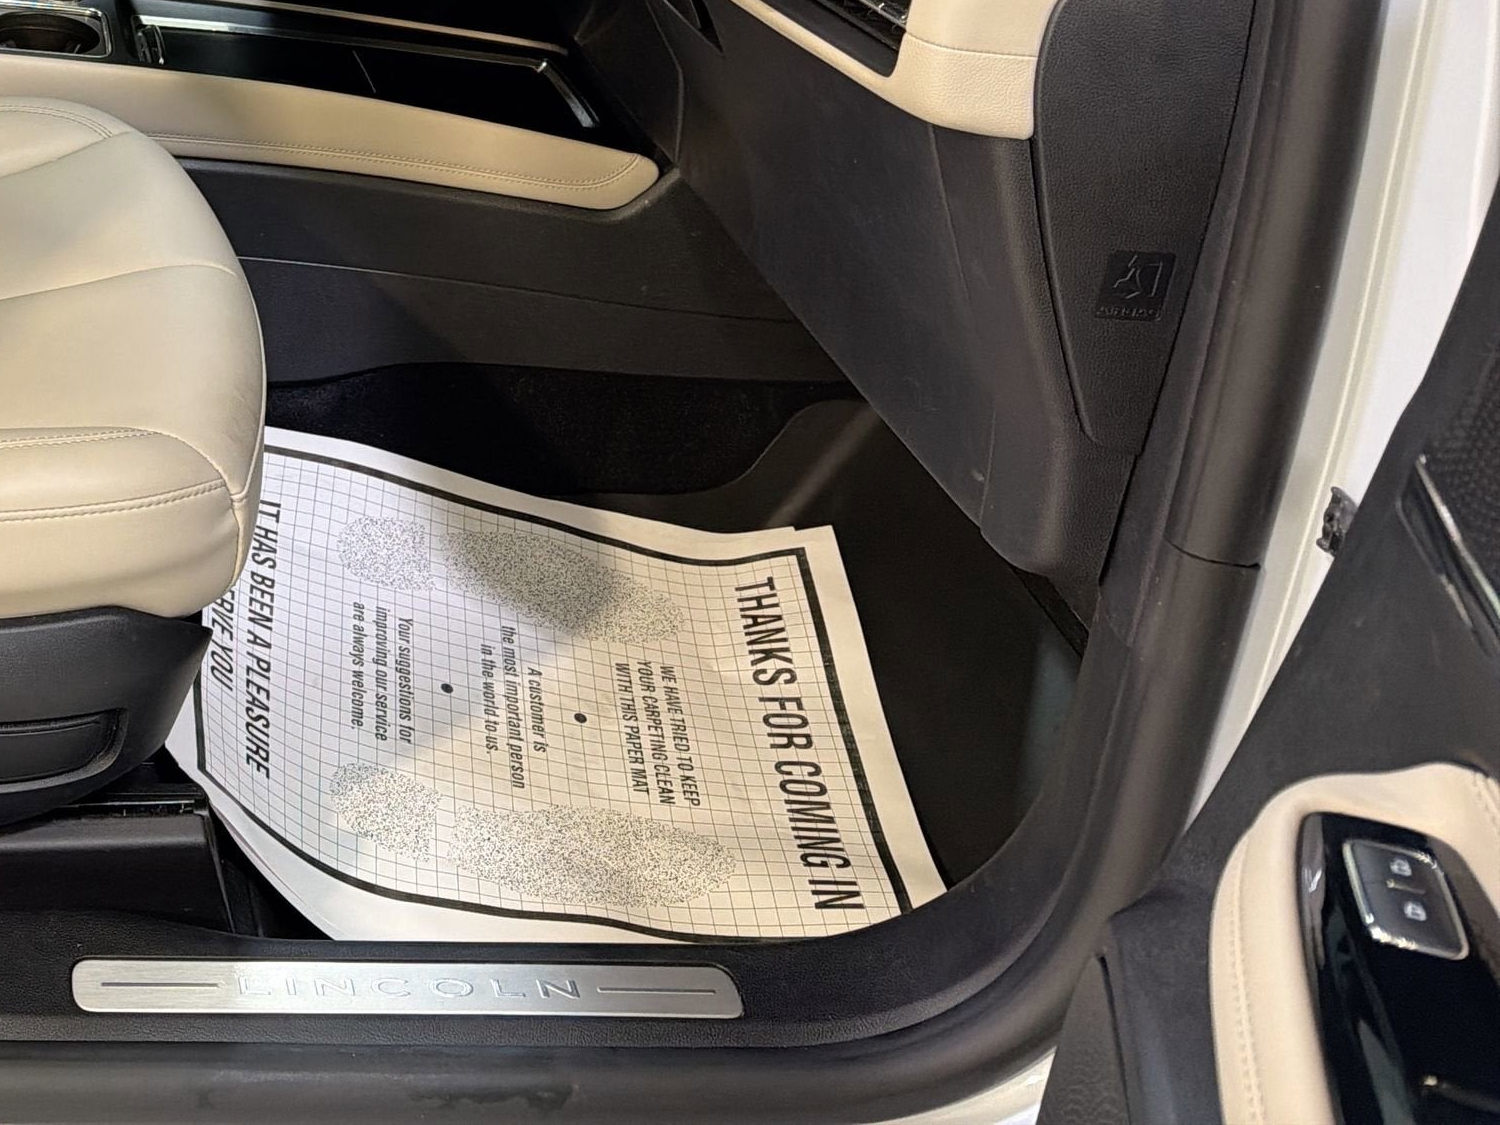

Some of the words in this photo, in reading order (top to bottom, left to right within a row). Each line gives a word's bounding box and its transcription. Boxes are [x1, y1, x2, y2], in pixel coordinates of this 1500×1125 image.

[258, 499, 281, 523] IT
[251, 525, 278, 569] HAS
[247, 570, 275, 632] BEEN
[353, 601, 365, 622] are
[246, 629, 272, 649] A
[349, 624, 368, 667] always
[372, 606, 391, 667] improving
[398, 617, 413, 644] Your
[502, 625, 516, 644] the
[735, 576, 798, 685] THANKS
[210, 639, 234, 692] YOU
[481, 644, 496, 656] in
[502, 647, 520, 678] most
[375, 669, 388, 692] our
[481, 657, 496, 678] the
[527, 667, 543, 676] A
[615, 662, 633, 693] WITH
[637, 661, 656, 692] YOUR
[660, 665, 677, 684] WE
[395, 646, 414, 722] suggestions
[482, 681, 500, 718] world
[245, 651, 272, 779] PLEASURE
[351, 670, 367, 730] welcome.
[504, 680, 522, 742] important
[528, 680, 546, 739] customer
[619, 696, 638, 721] THIS
[664, 685, 684, 715] HAVE
[375, 693, 391, 741] service
[484, 719, 499, 733] to
[642, 696, 668, 761] CARPETING
[758, 696, 813, 749] FOR
[399, 727, 415, 744] for
[486, 735, 499, 755] us.
[534, 741, 549, 753] is
[624, 725, 644, 764] PAPER
[670, 717, 690, 752] TRIED
[506, 744, 525, 789] person
[676, 756, 694, 772] TO
[630, 768, 649, 795] MAT
[654, 764, 676, 805] CLEAN
[680, 775, 700, 806] KEEP
[774, 760, 851, 869] COMING
[808, 879, 866, 909] IN
[238, 977, 581, 1000] LINCOLN
